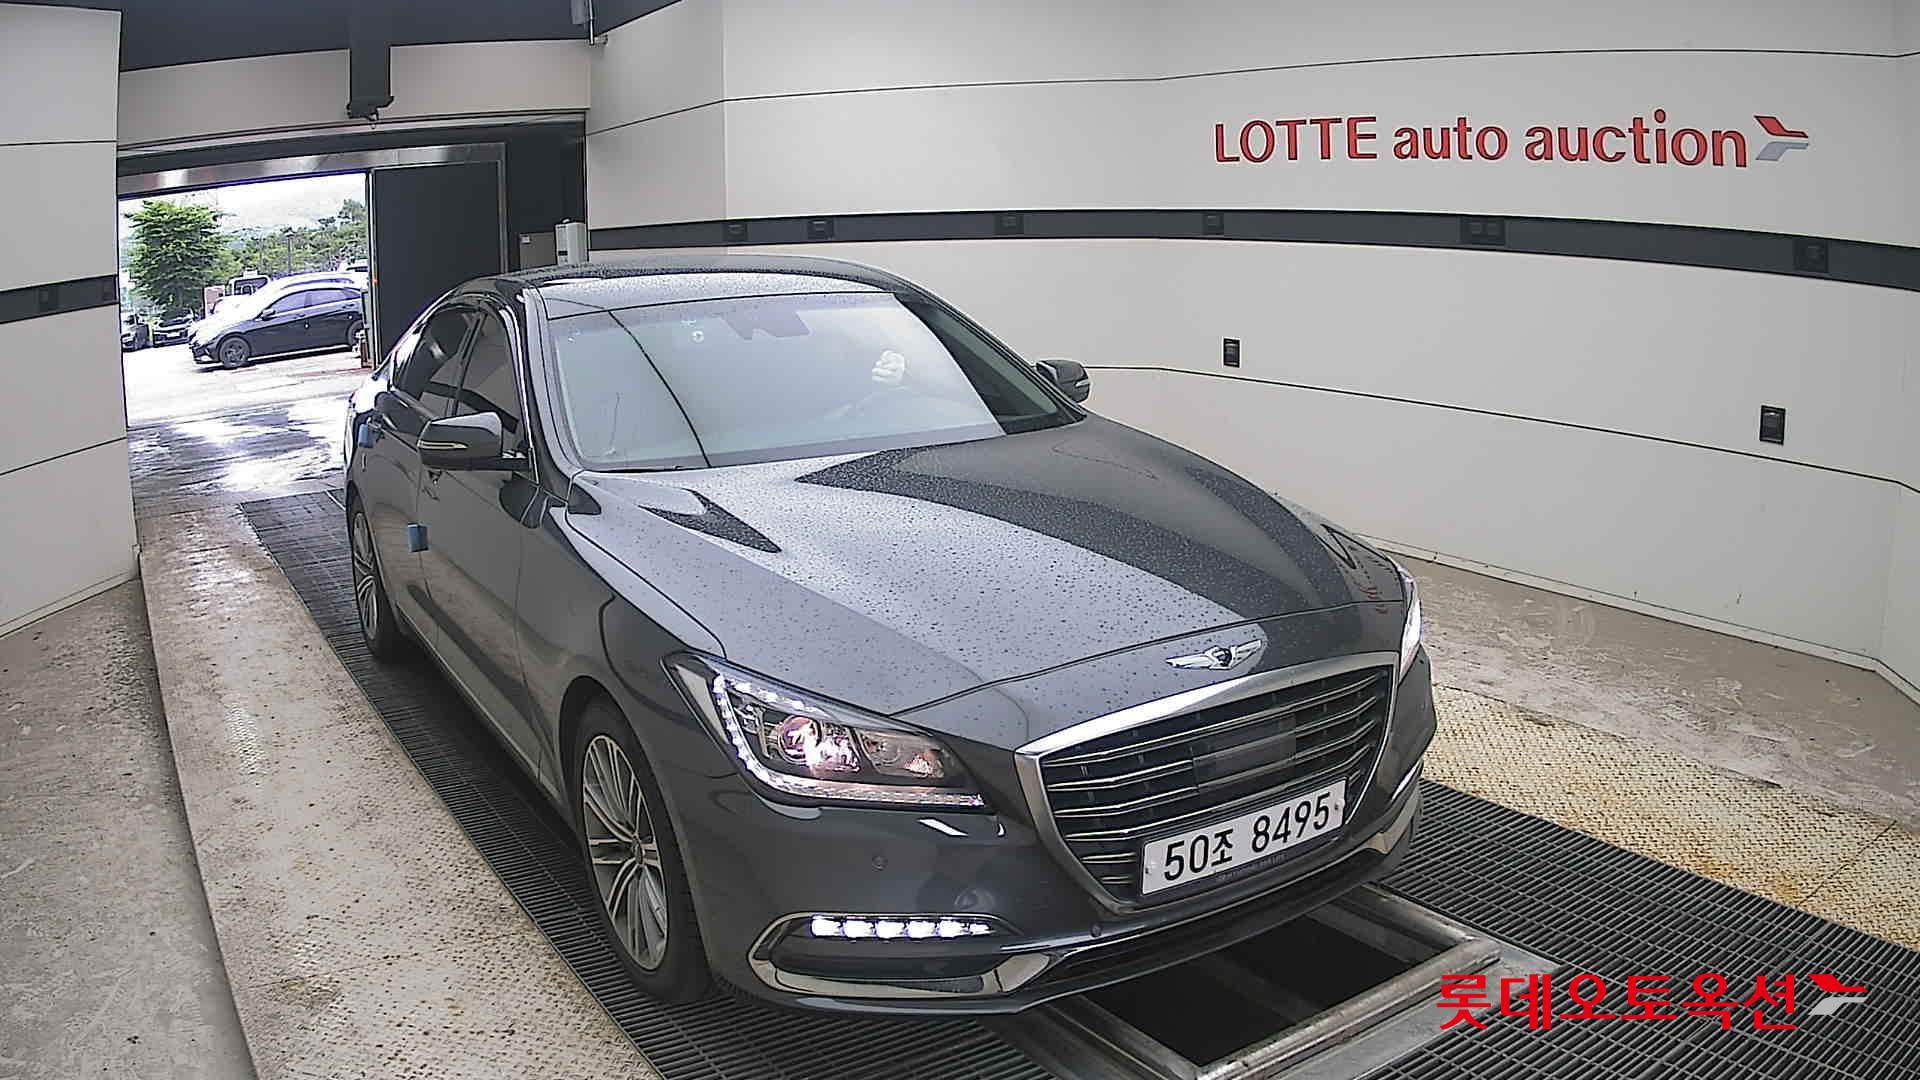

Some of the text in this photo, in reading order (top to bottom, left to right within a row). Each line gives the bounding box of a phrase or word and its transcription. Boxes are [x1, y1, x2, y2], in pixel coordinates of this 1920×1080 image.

[1214, 109, 1748, 168] LOTTE auto auction
[1164, 828, 1234, 881] 50조
[1251, 792, 1331, 853] 8495
